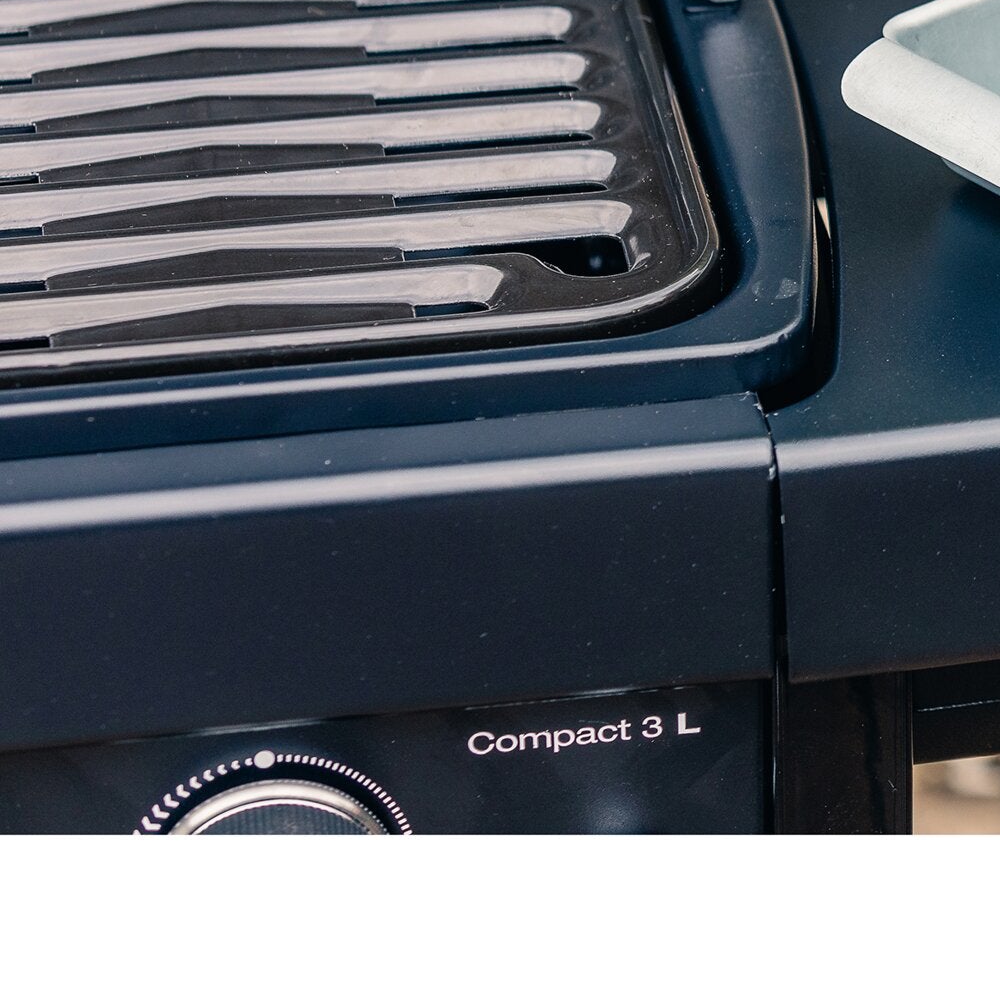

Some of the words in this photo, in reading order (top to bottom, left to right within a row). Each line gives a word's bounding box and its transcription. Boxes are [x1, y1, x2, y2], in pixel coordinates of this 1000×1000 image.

[467, 719, 632, 755] Compact
[641, 715, 663, 739] 3
[677, 712, 701, 735] L
